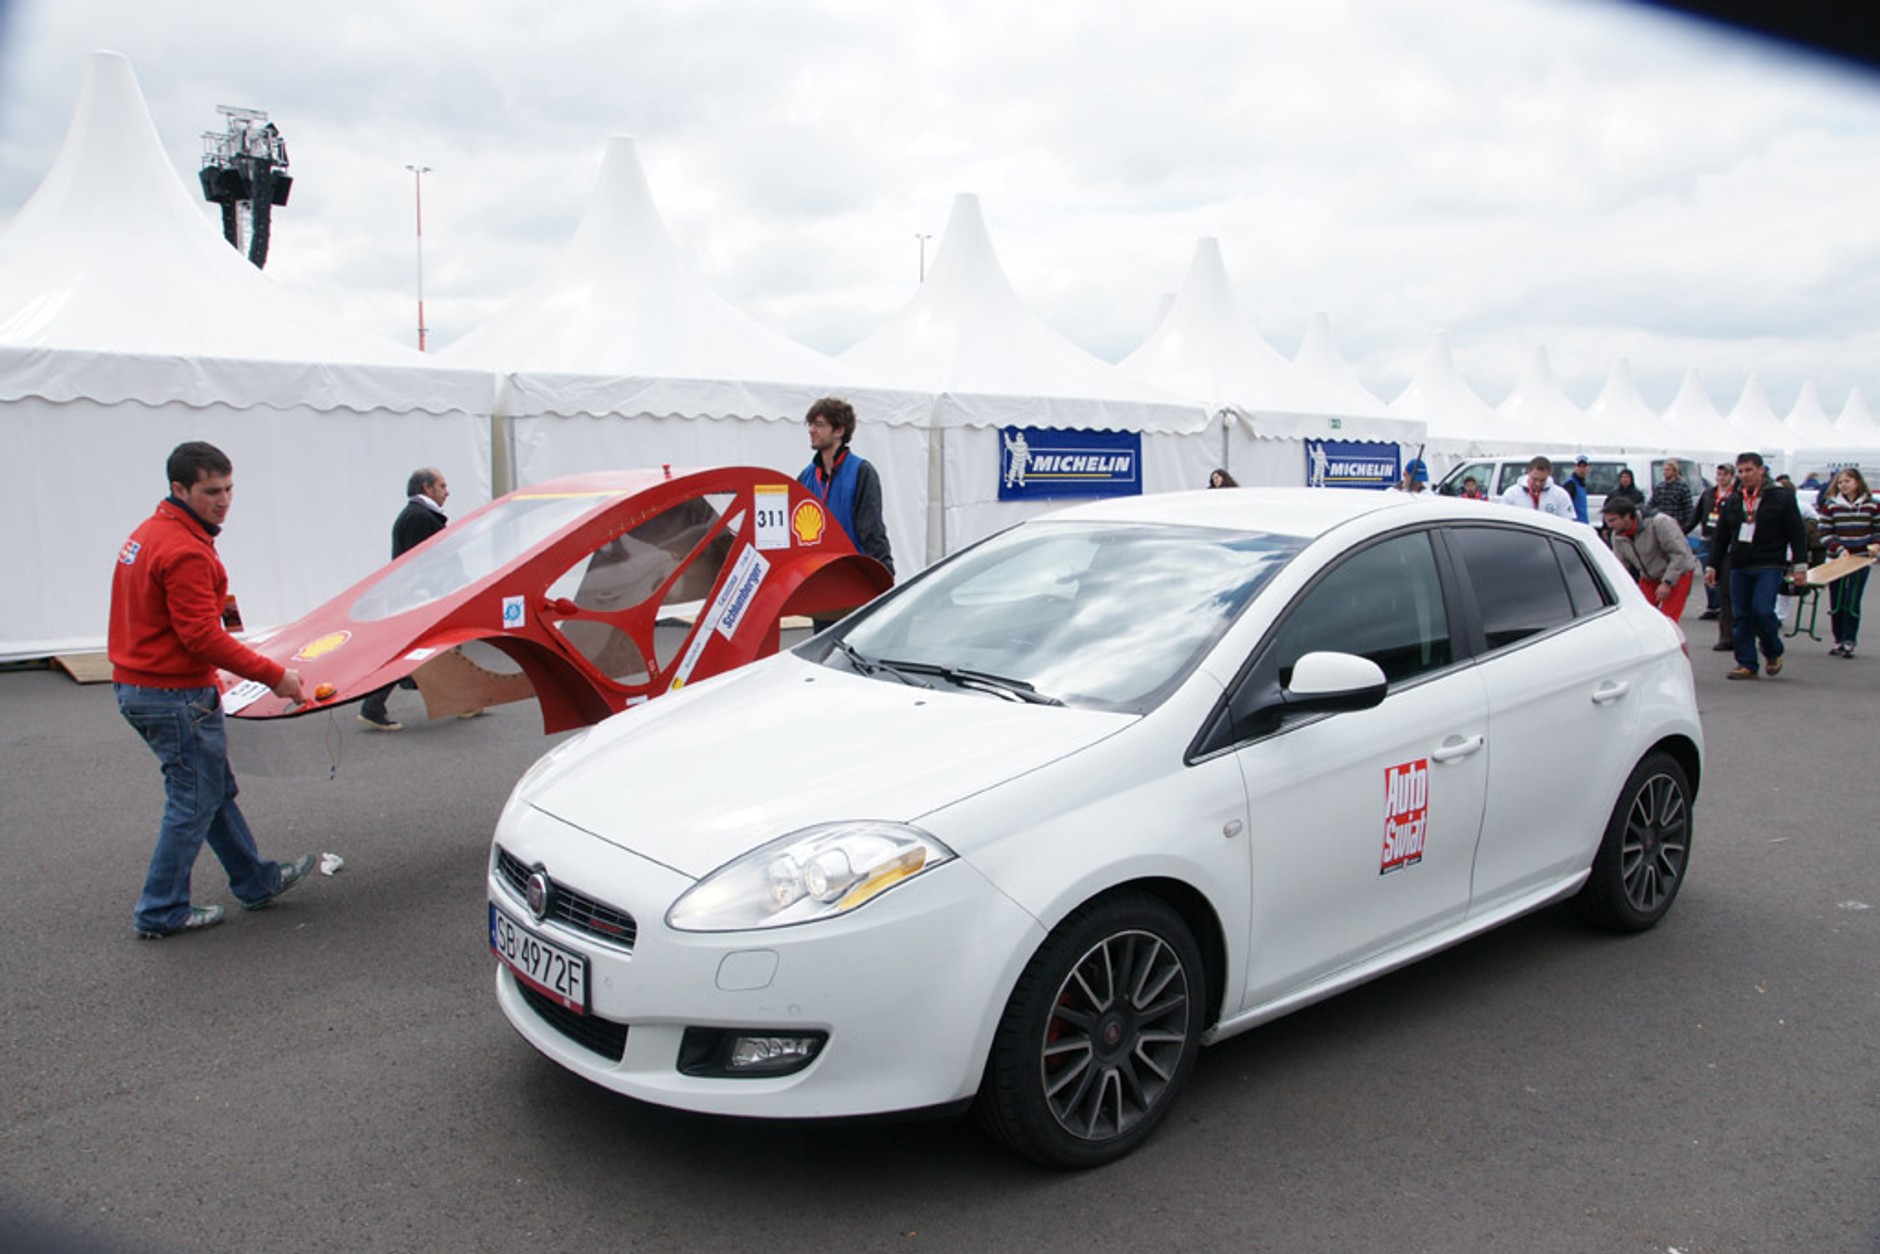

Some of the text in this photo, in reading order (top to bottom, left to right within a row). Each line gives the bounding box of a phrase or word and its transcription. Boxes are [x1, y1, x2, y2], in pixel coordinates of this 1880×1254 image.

[1032, 455, 1131, 472] MICHELIN
[1329, 462, 1394, 477] MICHELIN
[757, 510, 784, 529] 311
[722, 562, 762, 629] Schlumberger
[1385, 762, 1427, 818] Auto
[497, 915, 581, 997] SB 4972F
